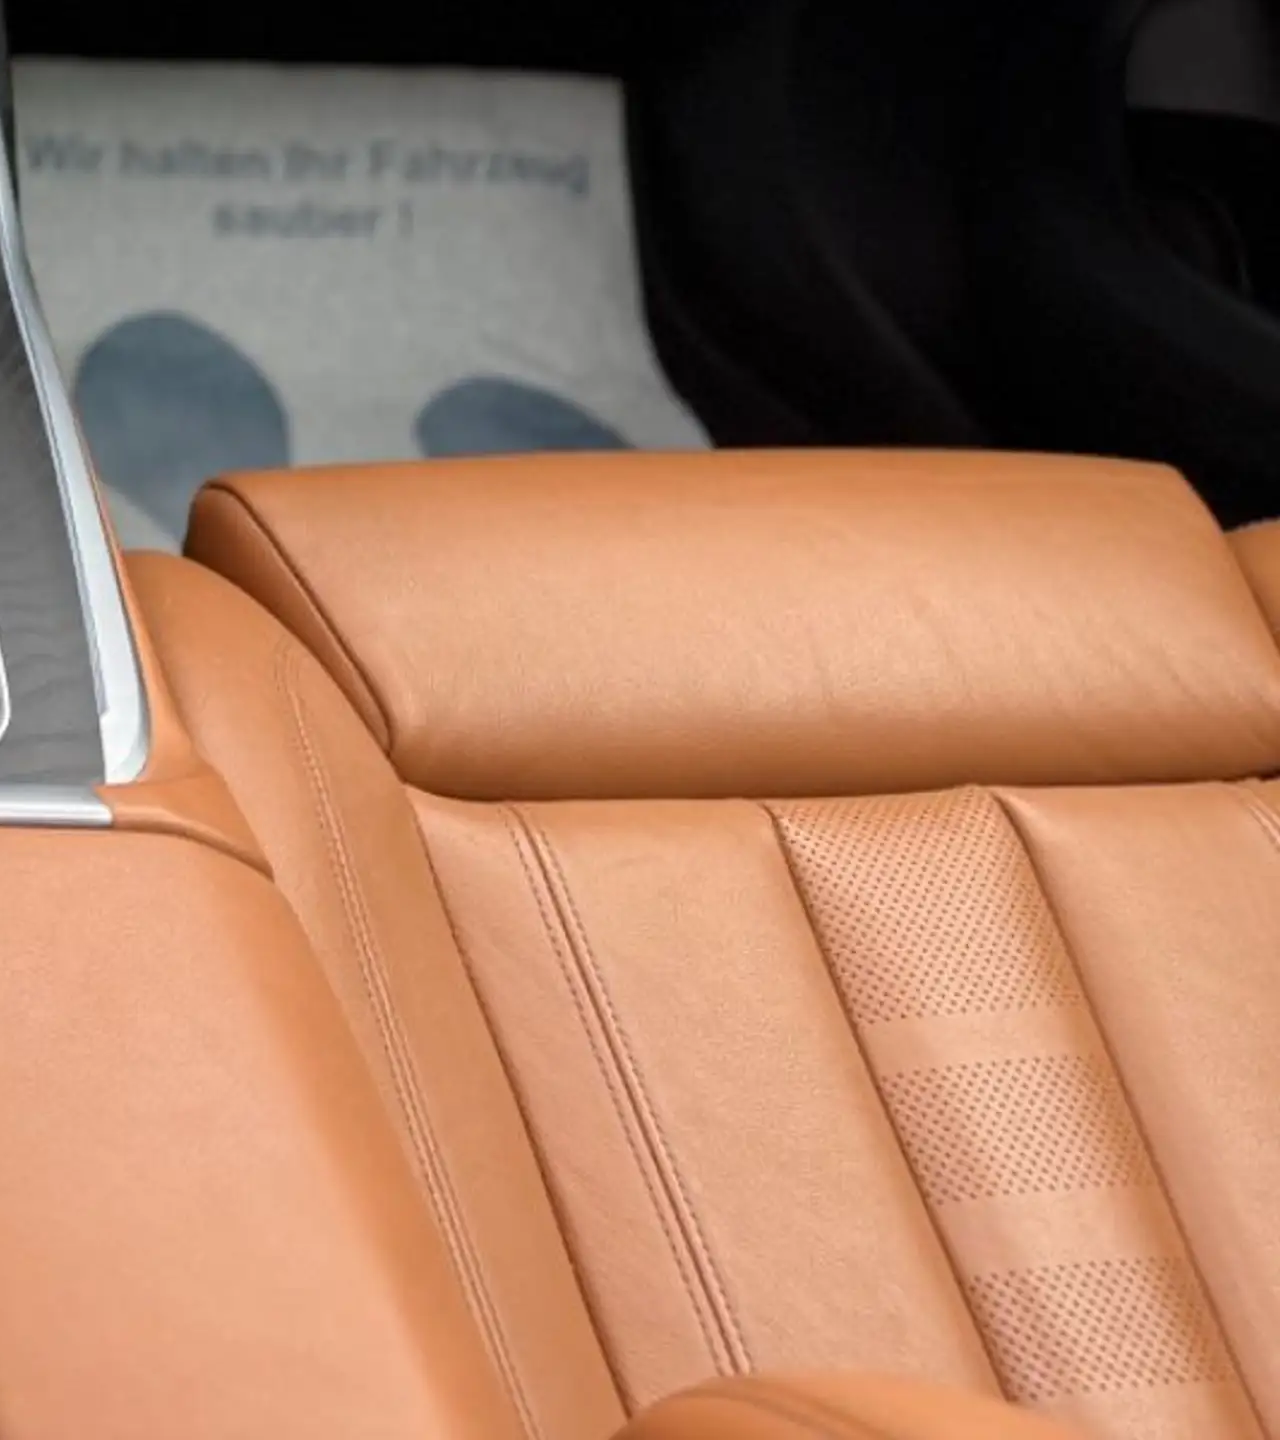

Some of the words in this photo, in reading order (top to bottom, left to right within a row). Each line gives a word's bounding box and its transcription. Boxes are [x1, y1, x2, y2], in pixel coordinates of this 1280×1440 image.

[283, 142, 348, 182] Ihr
[368, 138, 590, 201] Fahrzeug
[213, 201, 382, 239] sauber
